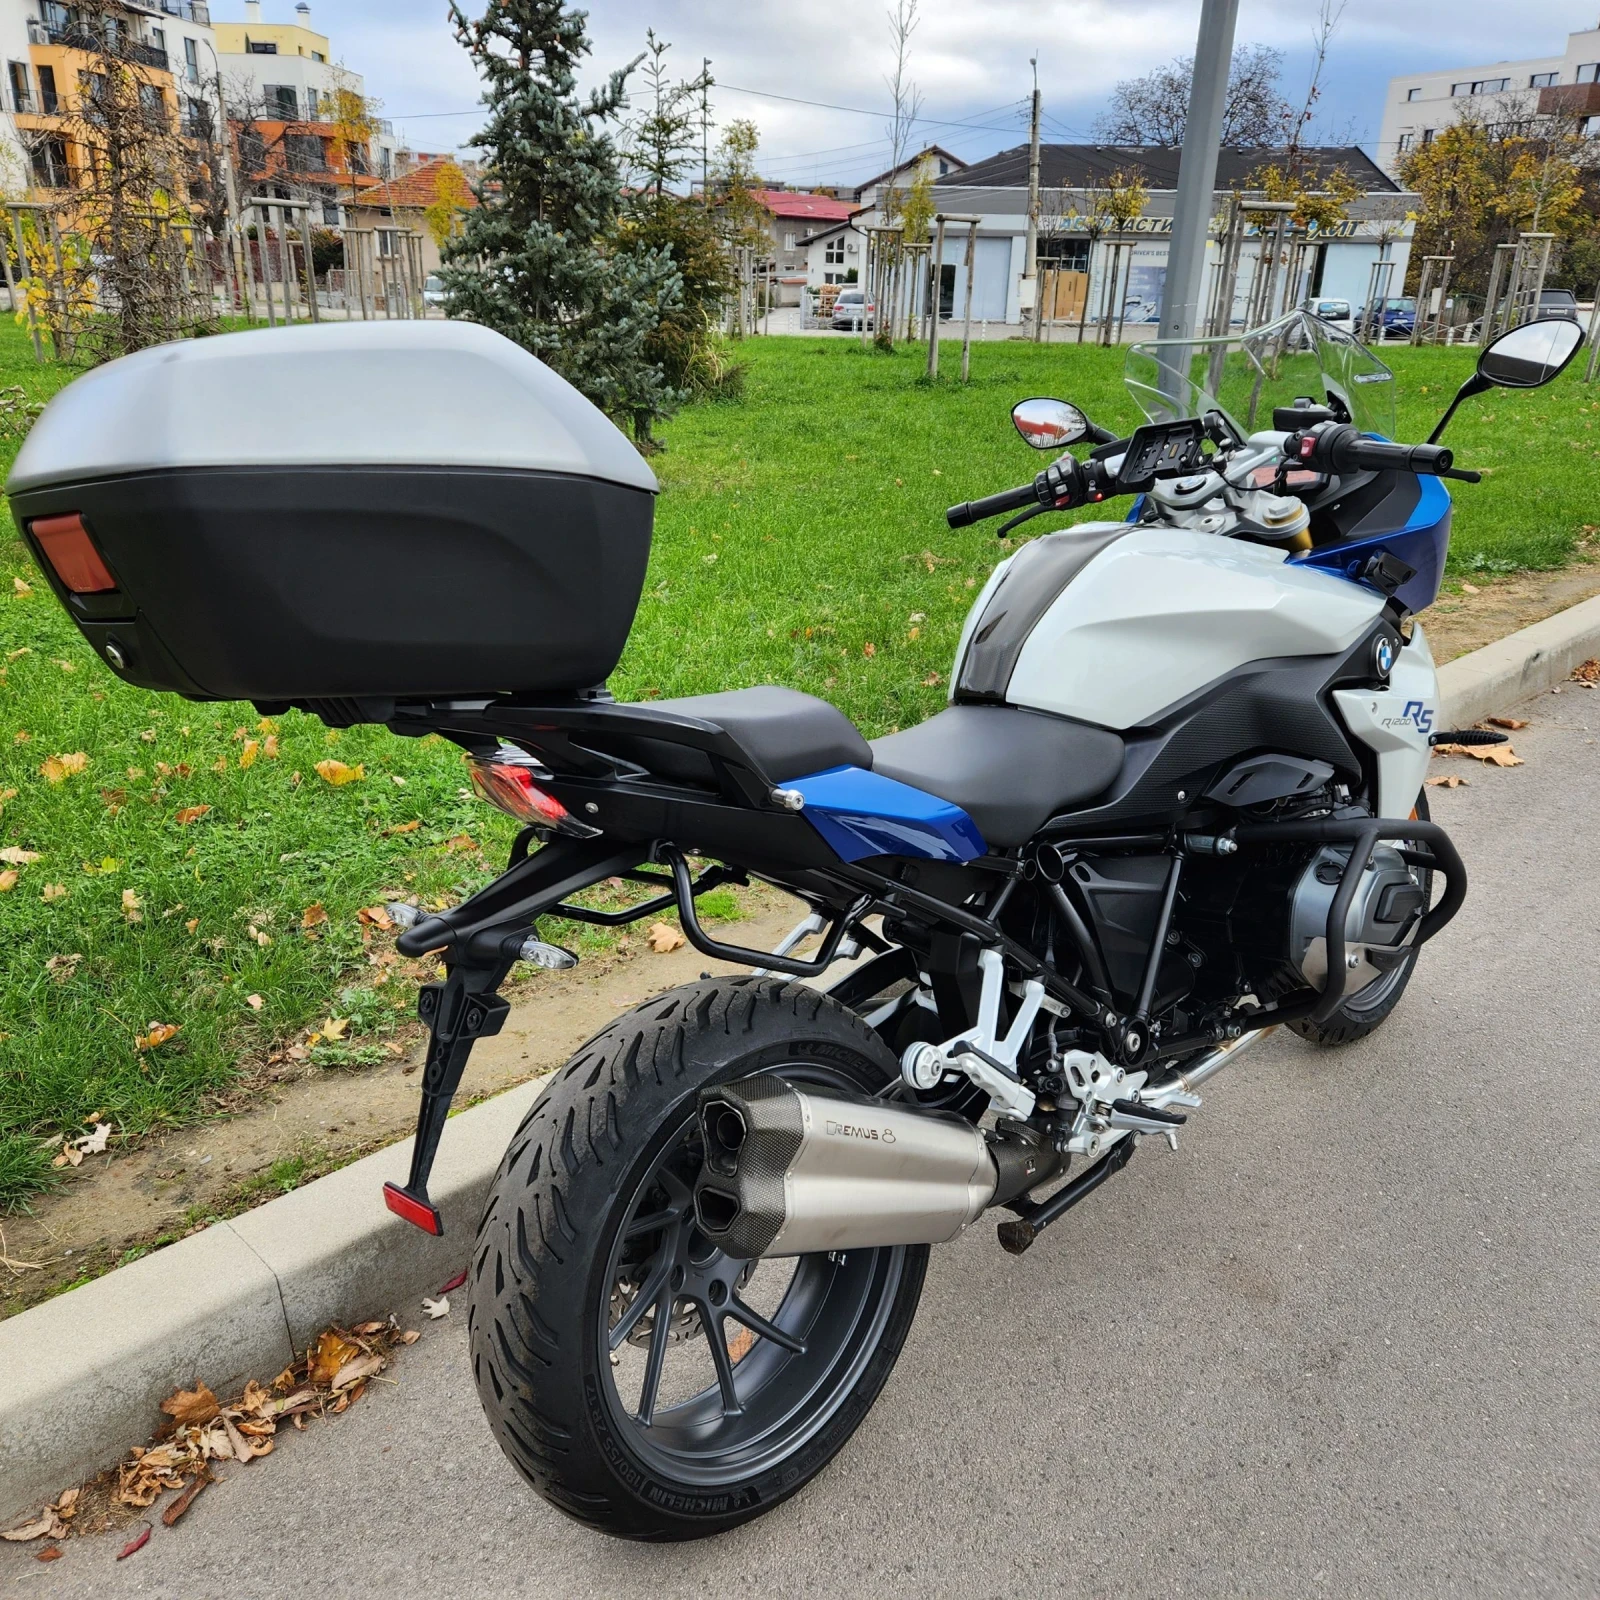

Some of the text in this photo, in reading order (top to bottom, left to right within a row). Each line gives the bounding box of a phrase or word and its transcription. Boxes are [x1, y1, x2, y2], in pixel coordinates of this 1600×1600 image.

[1403, 701, 1434, 733] RS
[814, 1044, 885, 1082] MICHELIN
[602, 1438, 641, 1488] 180/55
[647, 1488, 729, 1512] MICHELIN
